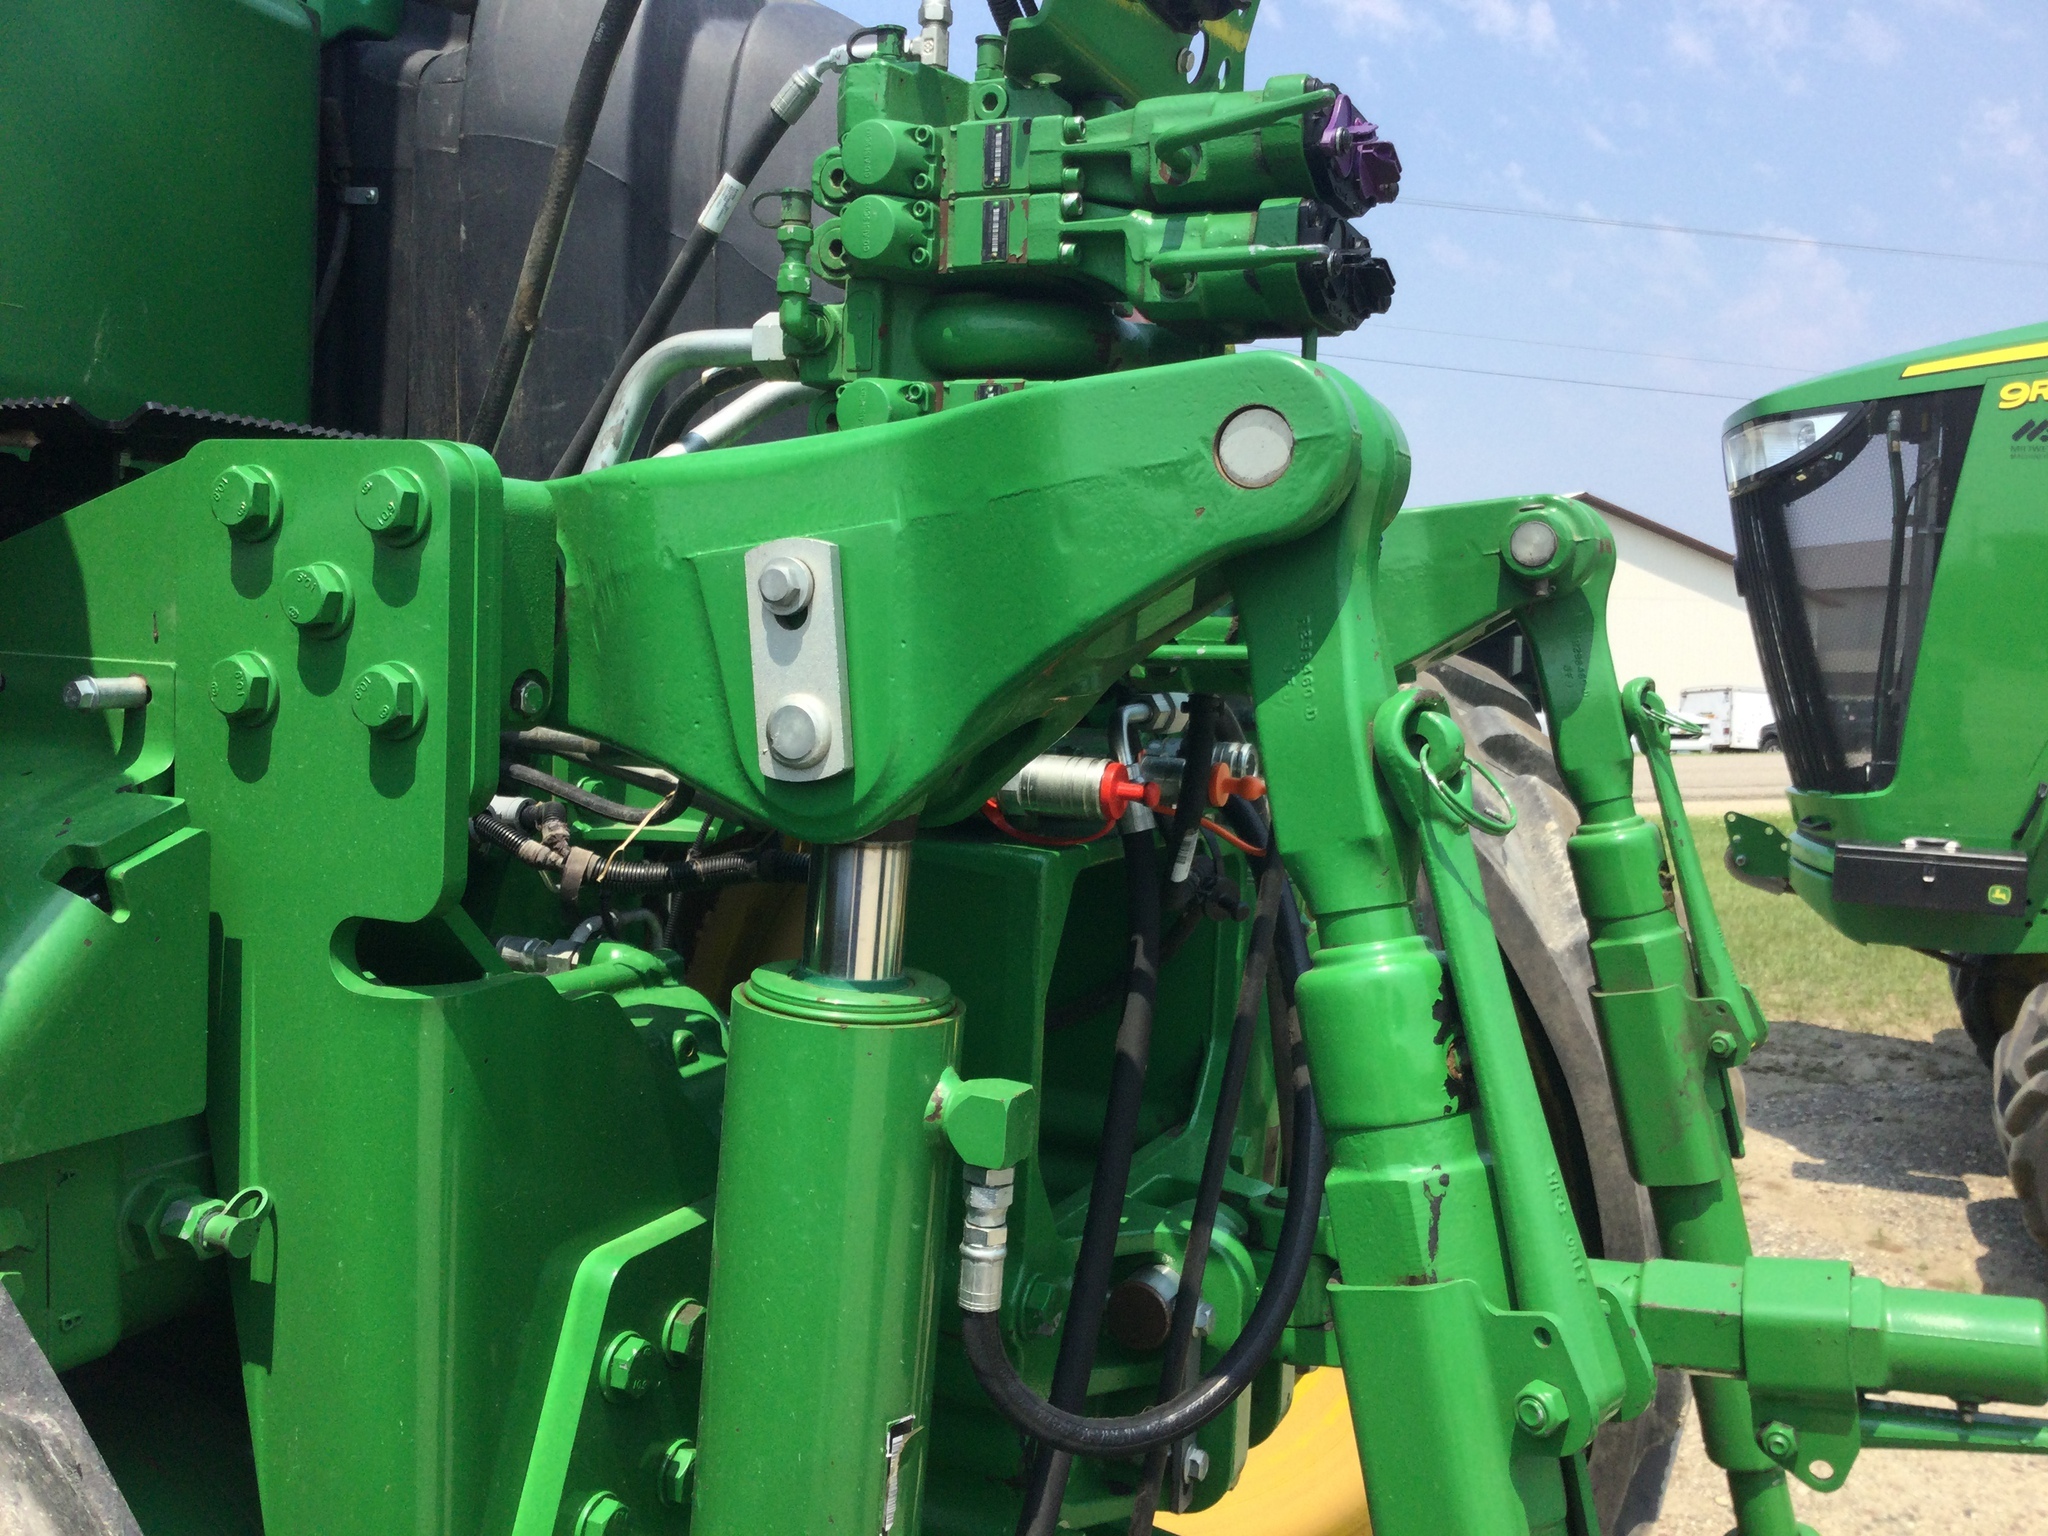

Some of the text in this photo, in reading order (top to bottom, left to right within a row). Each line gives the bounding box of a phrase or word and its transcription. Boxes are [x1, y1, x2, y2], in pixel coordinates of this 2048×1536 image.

[1998, 378, 2048, 410] 9R
[377, 501, 395, 527] 10.9
[355, 675, 372, 701] 10.9
